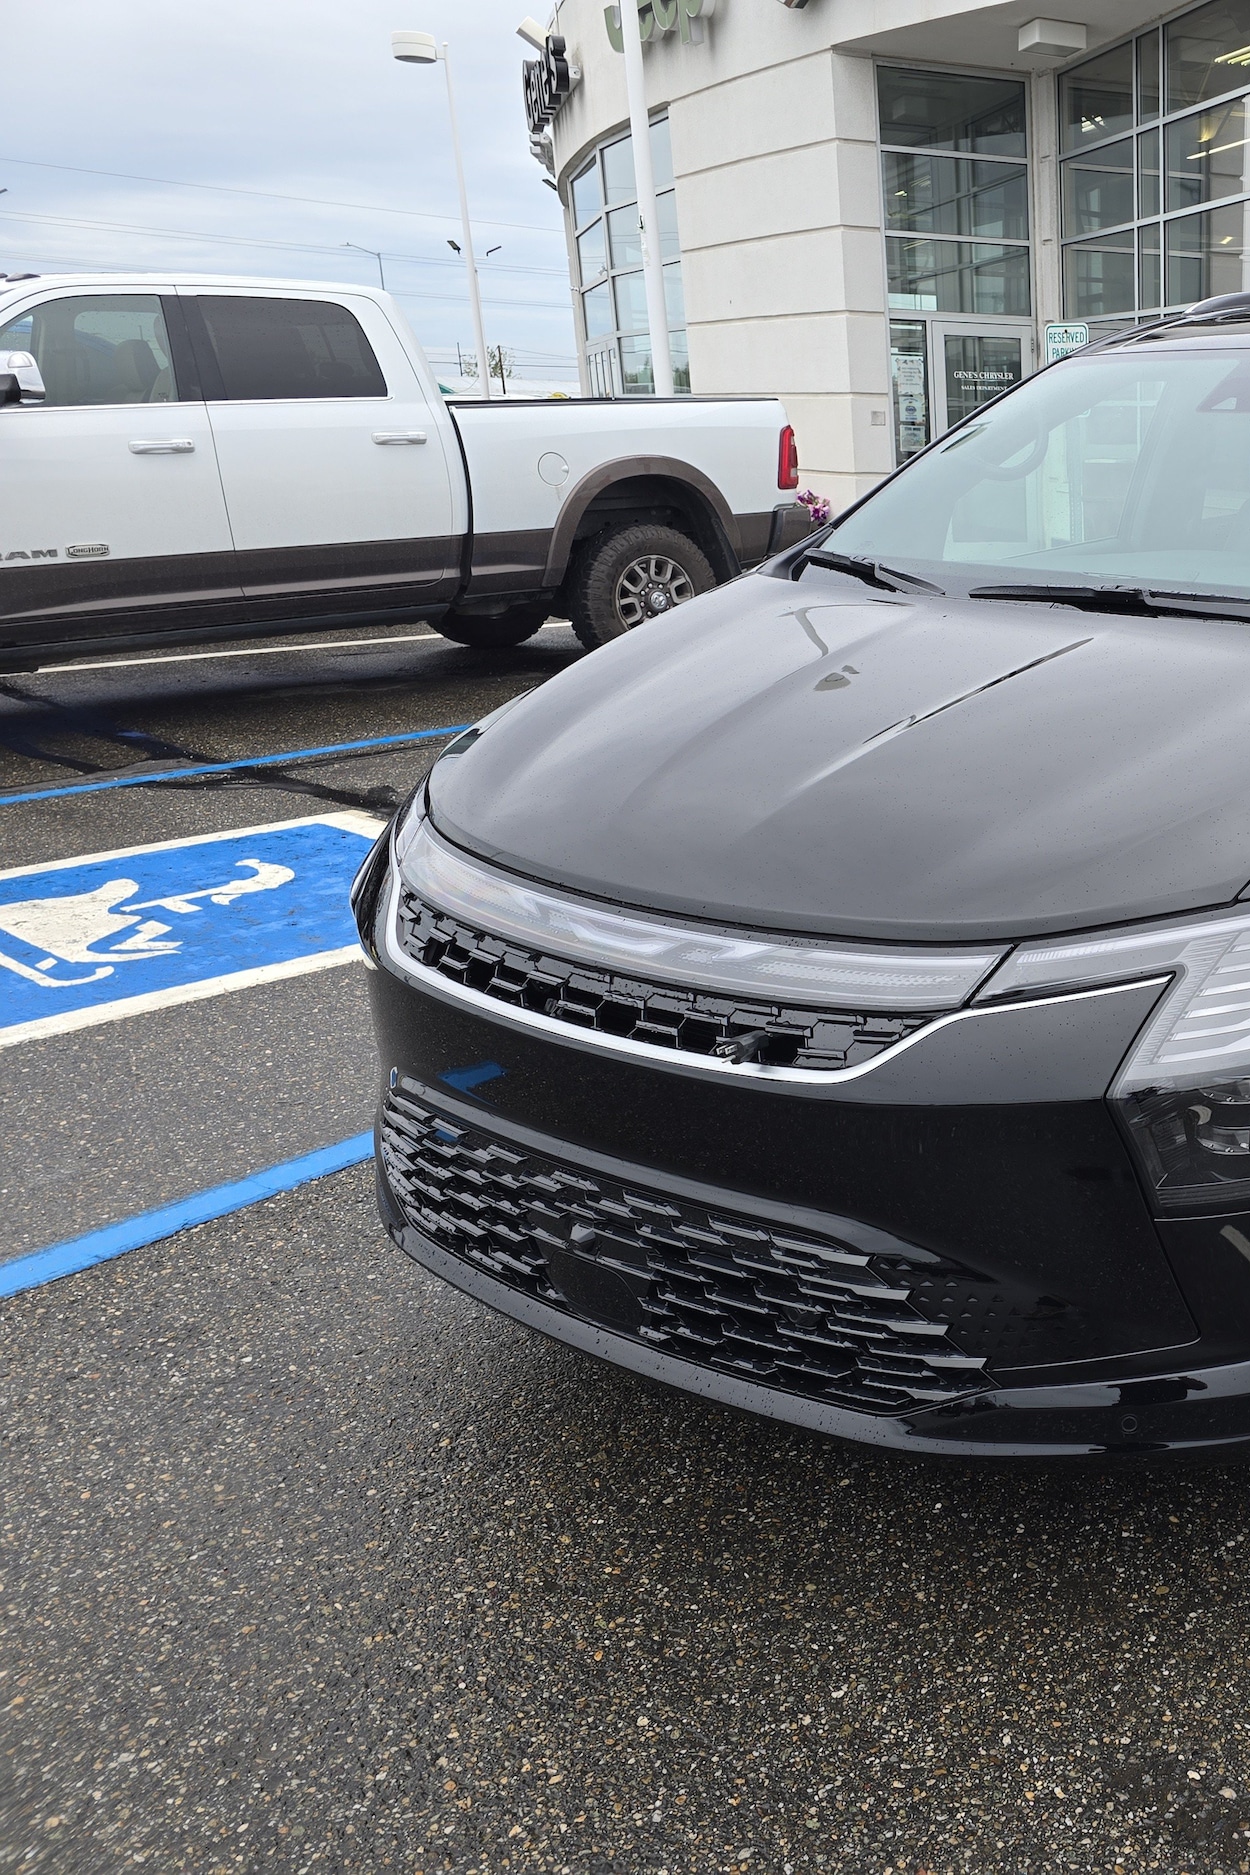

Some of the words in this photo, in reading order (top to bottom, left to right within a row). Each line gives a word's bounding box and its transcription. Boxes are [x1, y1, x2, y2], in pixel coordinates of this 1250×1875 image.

[603, 0, 708, 53] ep
[1048, 331, 1085, 344] RESERVED
[1052, 347, 1077, 359] PARK
[953, 370, 978, 379] GENE'S
[979, 371, 1014, 380] CHRYSLER
[0, 549, 58, 560] AM
